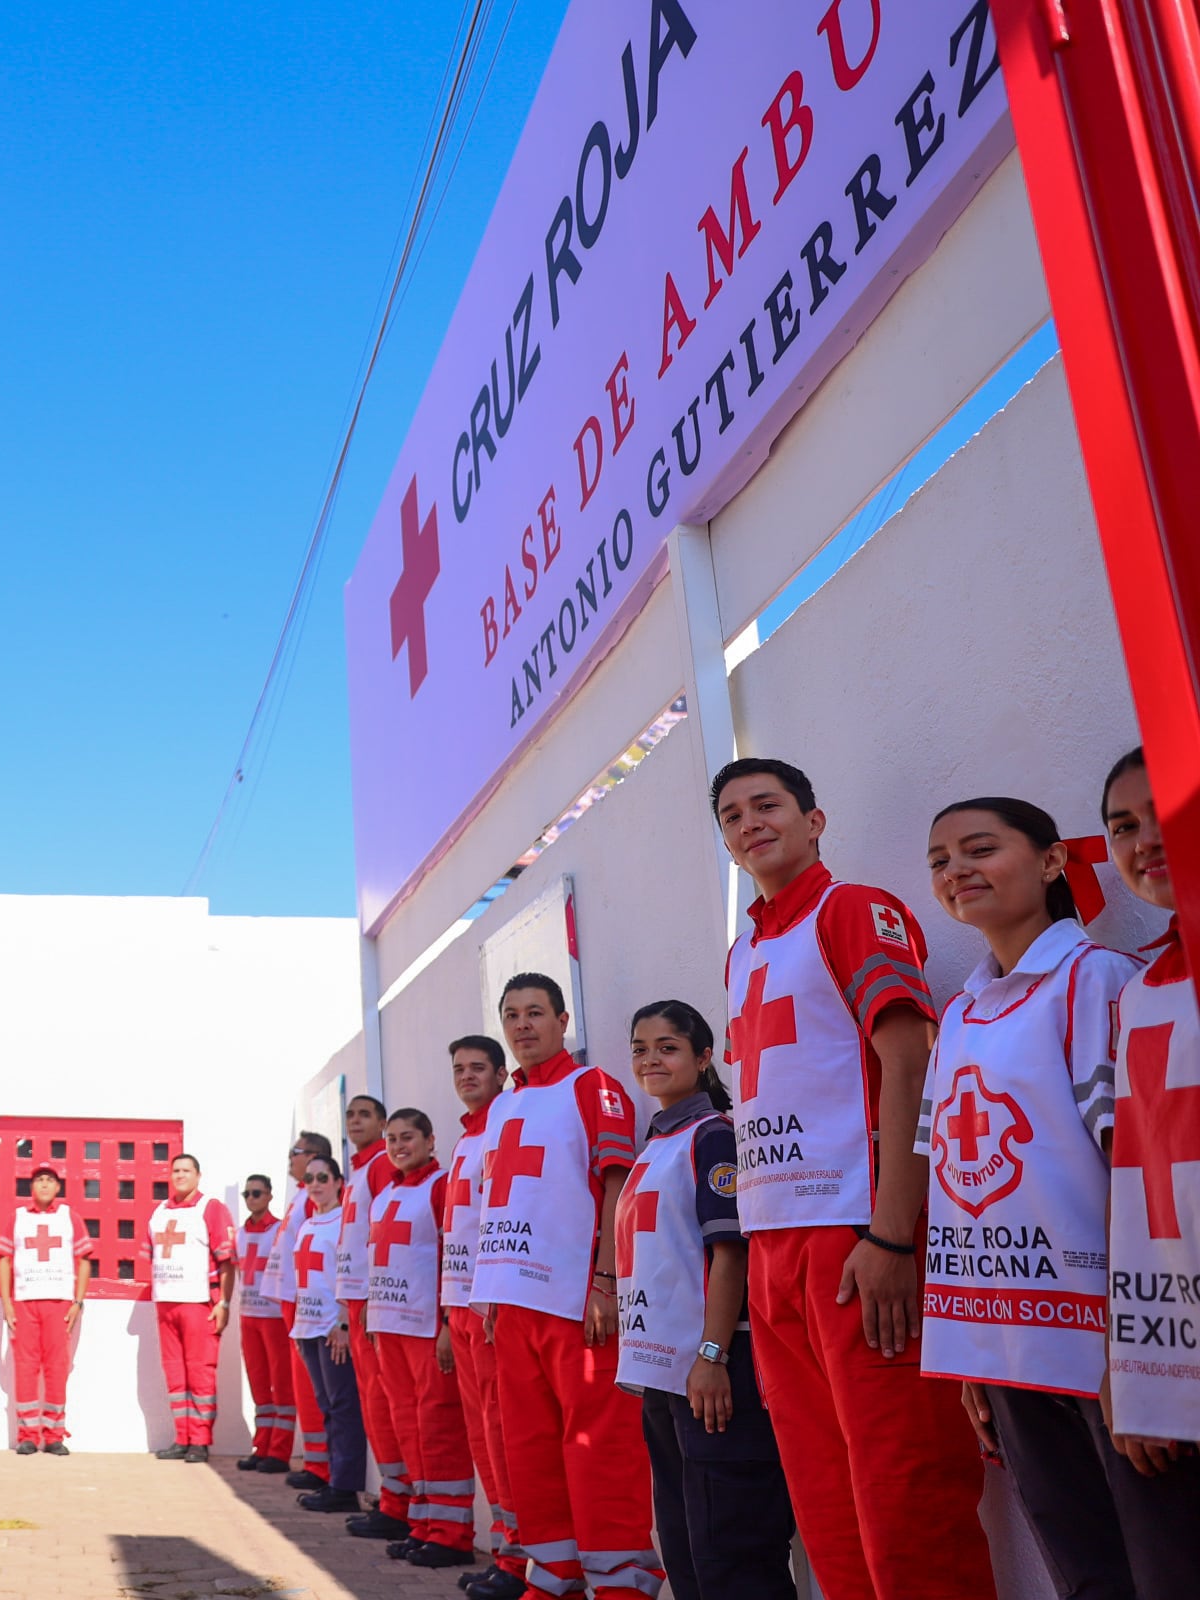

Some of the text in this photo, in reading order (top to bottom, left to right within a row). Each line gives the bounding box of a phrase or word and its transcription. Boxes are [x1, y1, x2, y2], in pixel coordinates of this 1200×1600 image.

[452, 0, 698, 524] CRUZ ROJA
[480, 0, 881, 669] BASE DE AMBU
[510, 0, 1002, 729] ANTONIO GUTIERREZ
[748, 1113, 804, 1140] ROJA
[947, 1153, 1005, 1187] JUVENTUD
[497, 1220, 533, 1236] ROJA
[927, 1225, 1053, 1250] CRUZ ROJA
[926, 1252, 1058, 1279] MEXICANA
[1018, 1300, 1107, 1328] SOCIAL
[1110, 1313, 1197, 1350] EXIC
